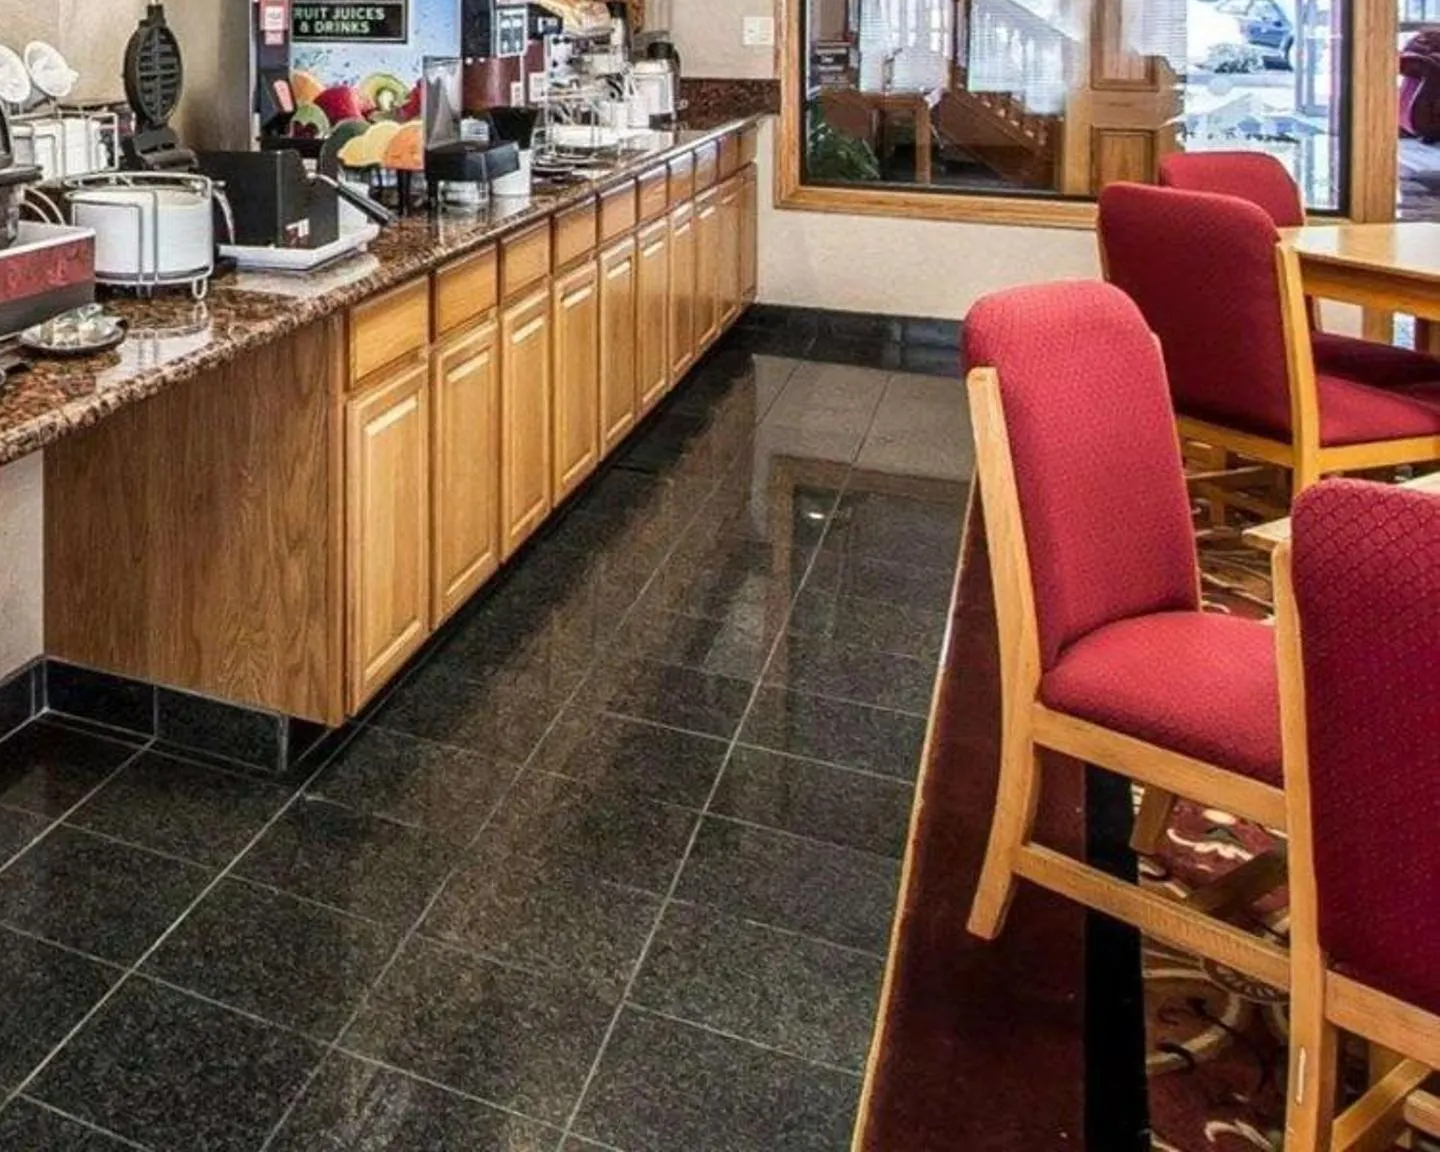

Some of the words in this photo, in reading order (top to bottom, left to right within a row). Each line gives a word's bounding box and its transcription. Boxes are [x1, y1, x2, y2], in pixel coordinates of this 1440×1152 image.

[292, 7, 328, 21] RUIT
[332, 6, 386, 21] JUICES
[299, 21, 310, 34] &
[313, 20, 371, 34] DRINKS
